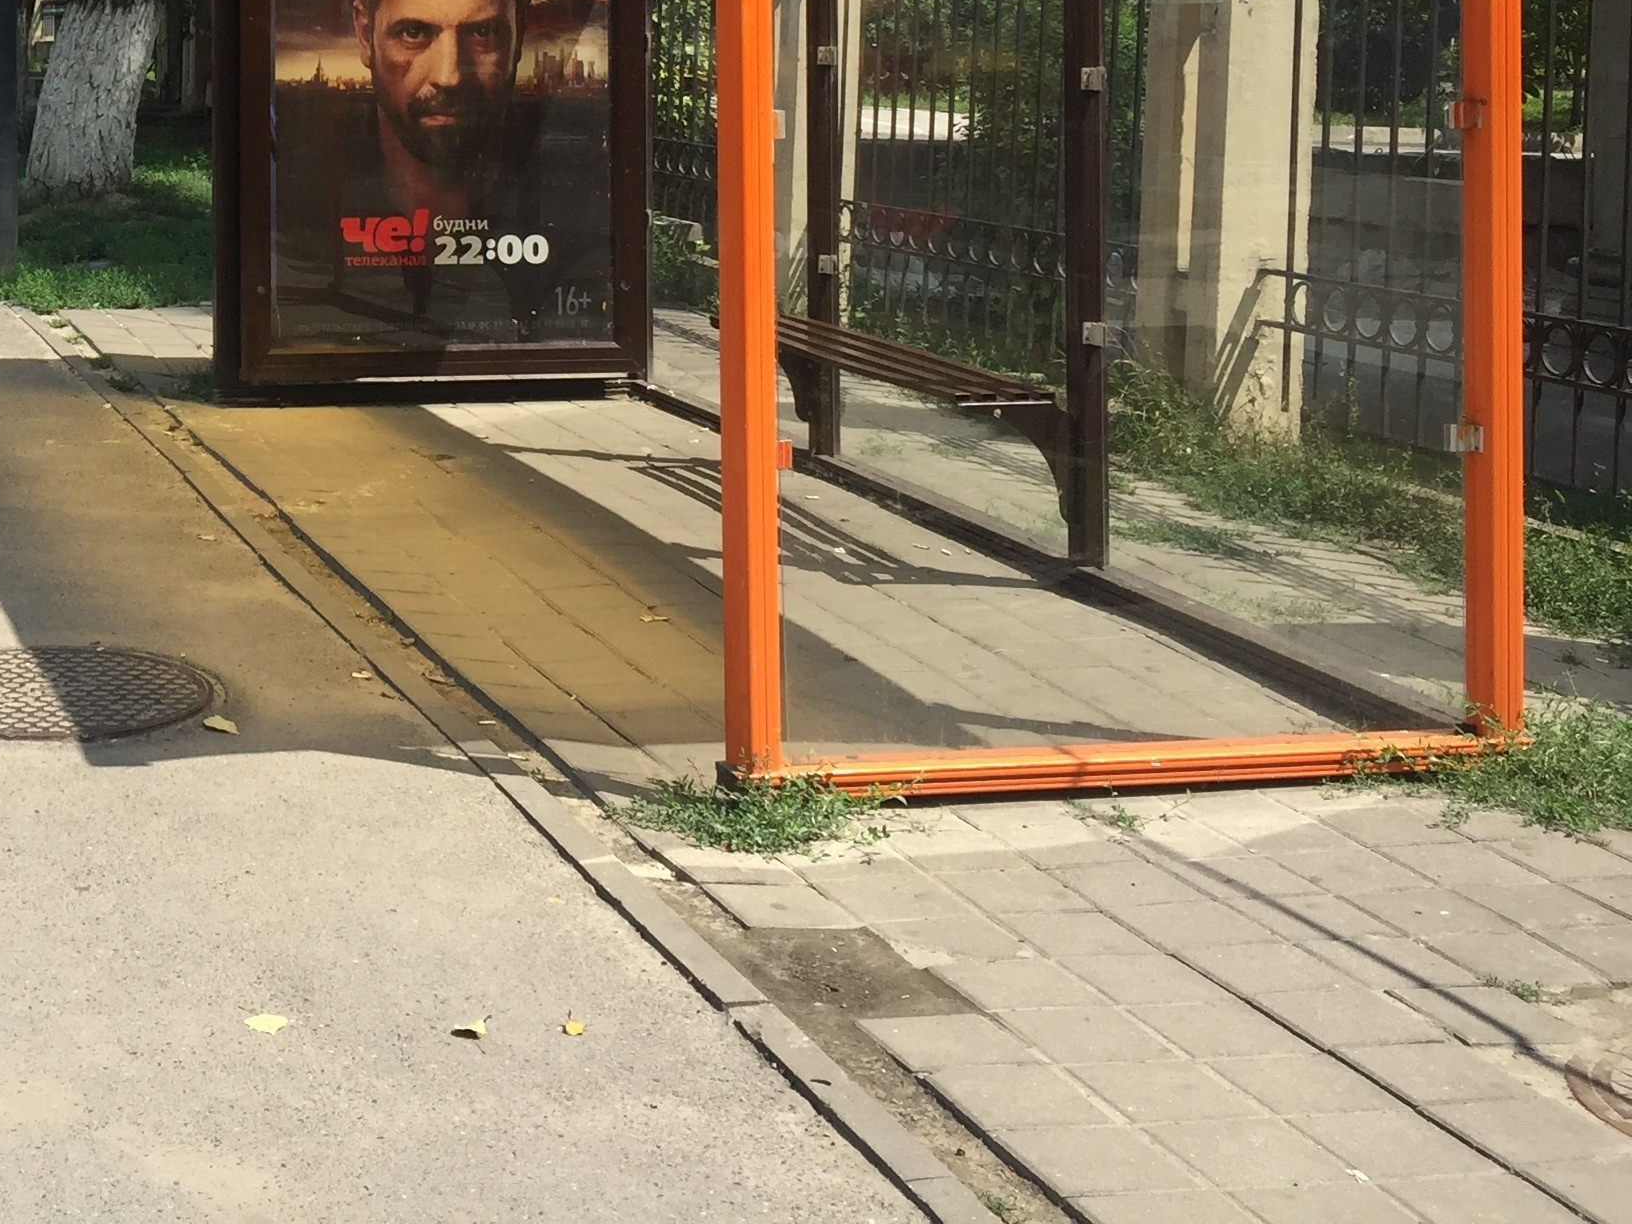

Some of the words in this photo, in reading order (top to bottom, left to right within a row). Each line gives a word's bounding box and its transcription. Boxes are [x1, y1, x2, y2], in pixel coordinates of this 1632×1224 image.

[433, 215, 489, 234] будни
[345, 255, 426, 267] телеканал
[434, 234, 550, 265] 22:00
[554, 286, 593, 316] 16+
